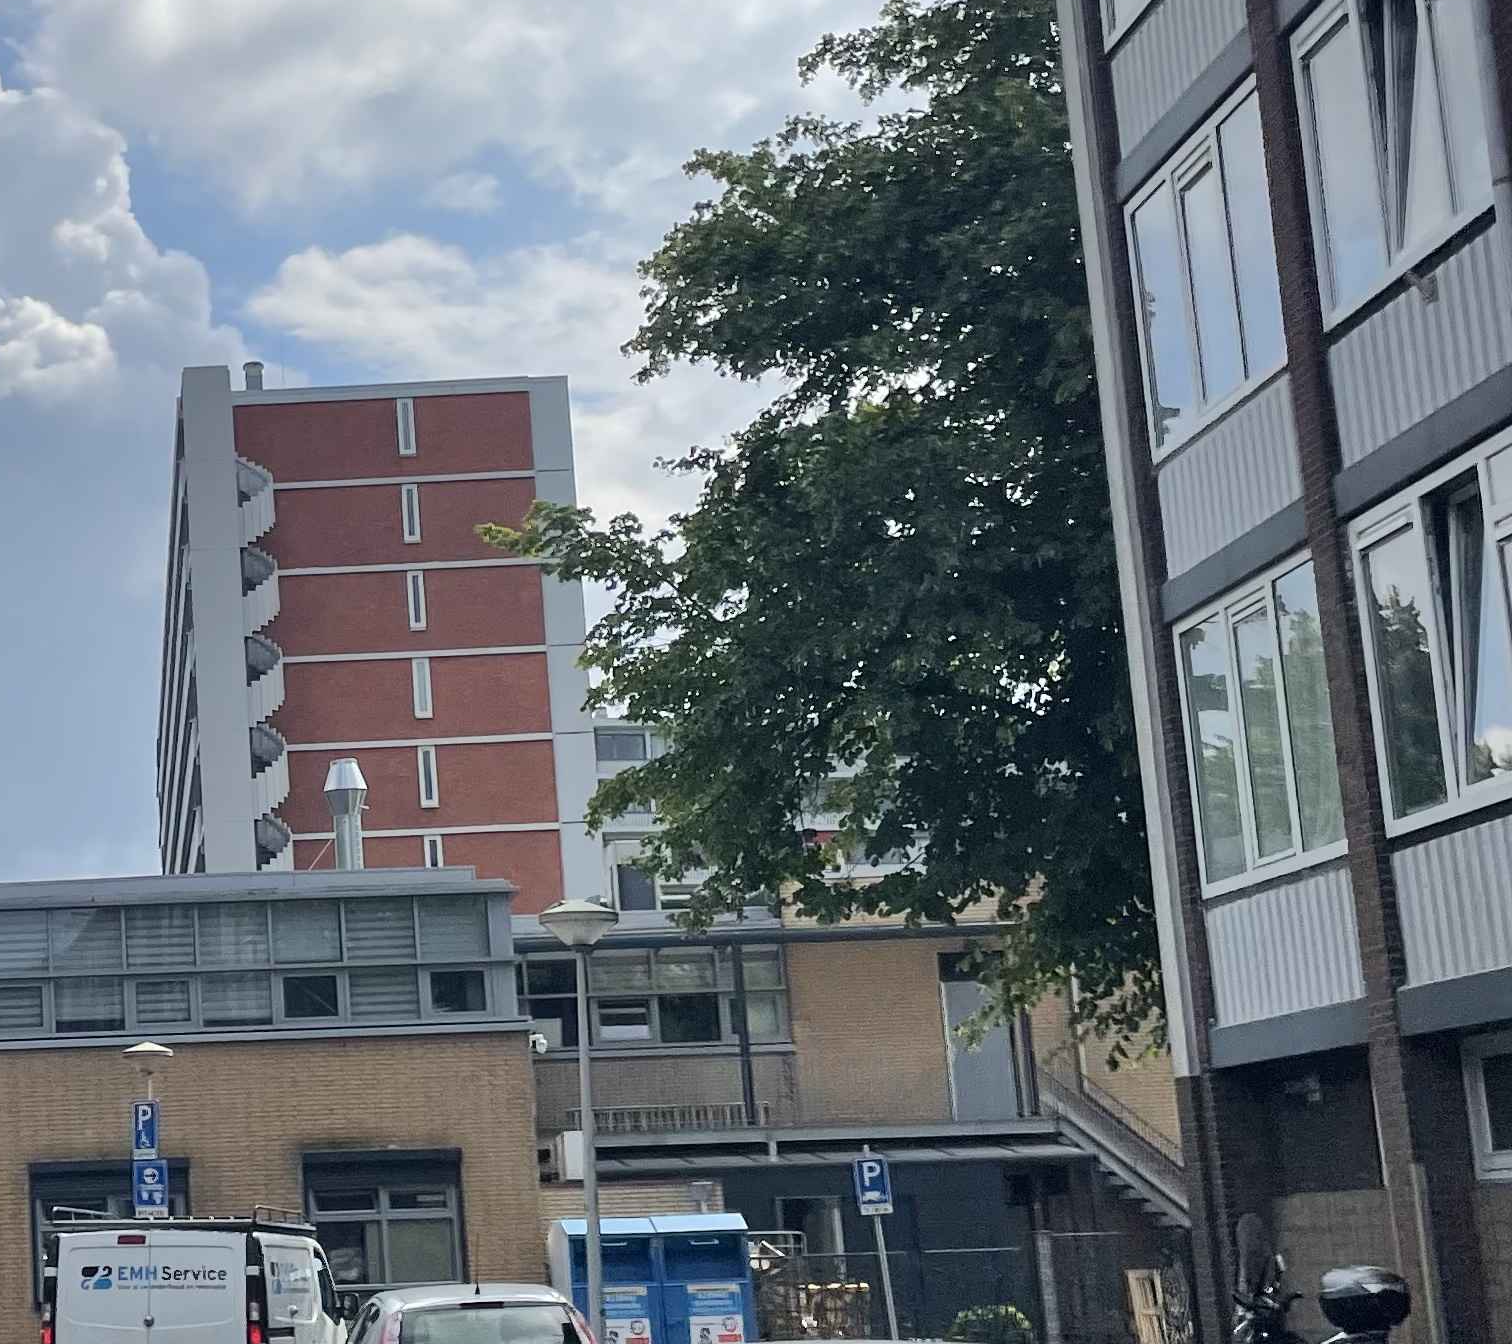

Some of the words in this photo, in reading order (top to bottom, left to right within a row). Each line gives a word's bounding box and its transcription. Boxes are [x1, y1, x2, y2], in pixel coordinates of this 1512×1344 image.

[138, 1104, 152, 1131] P
[862, 1161, 881, 1187] P
[117, 1265, 158, 1281] EMH
[161, 1265, 228, 1281] Service
